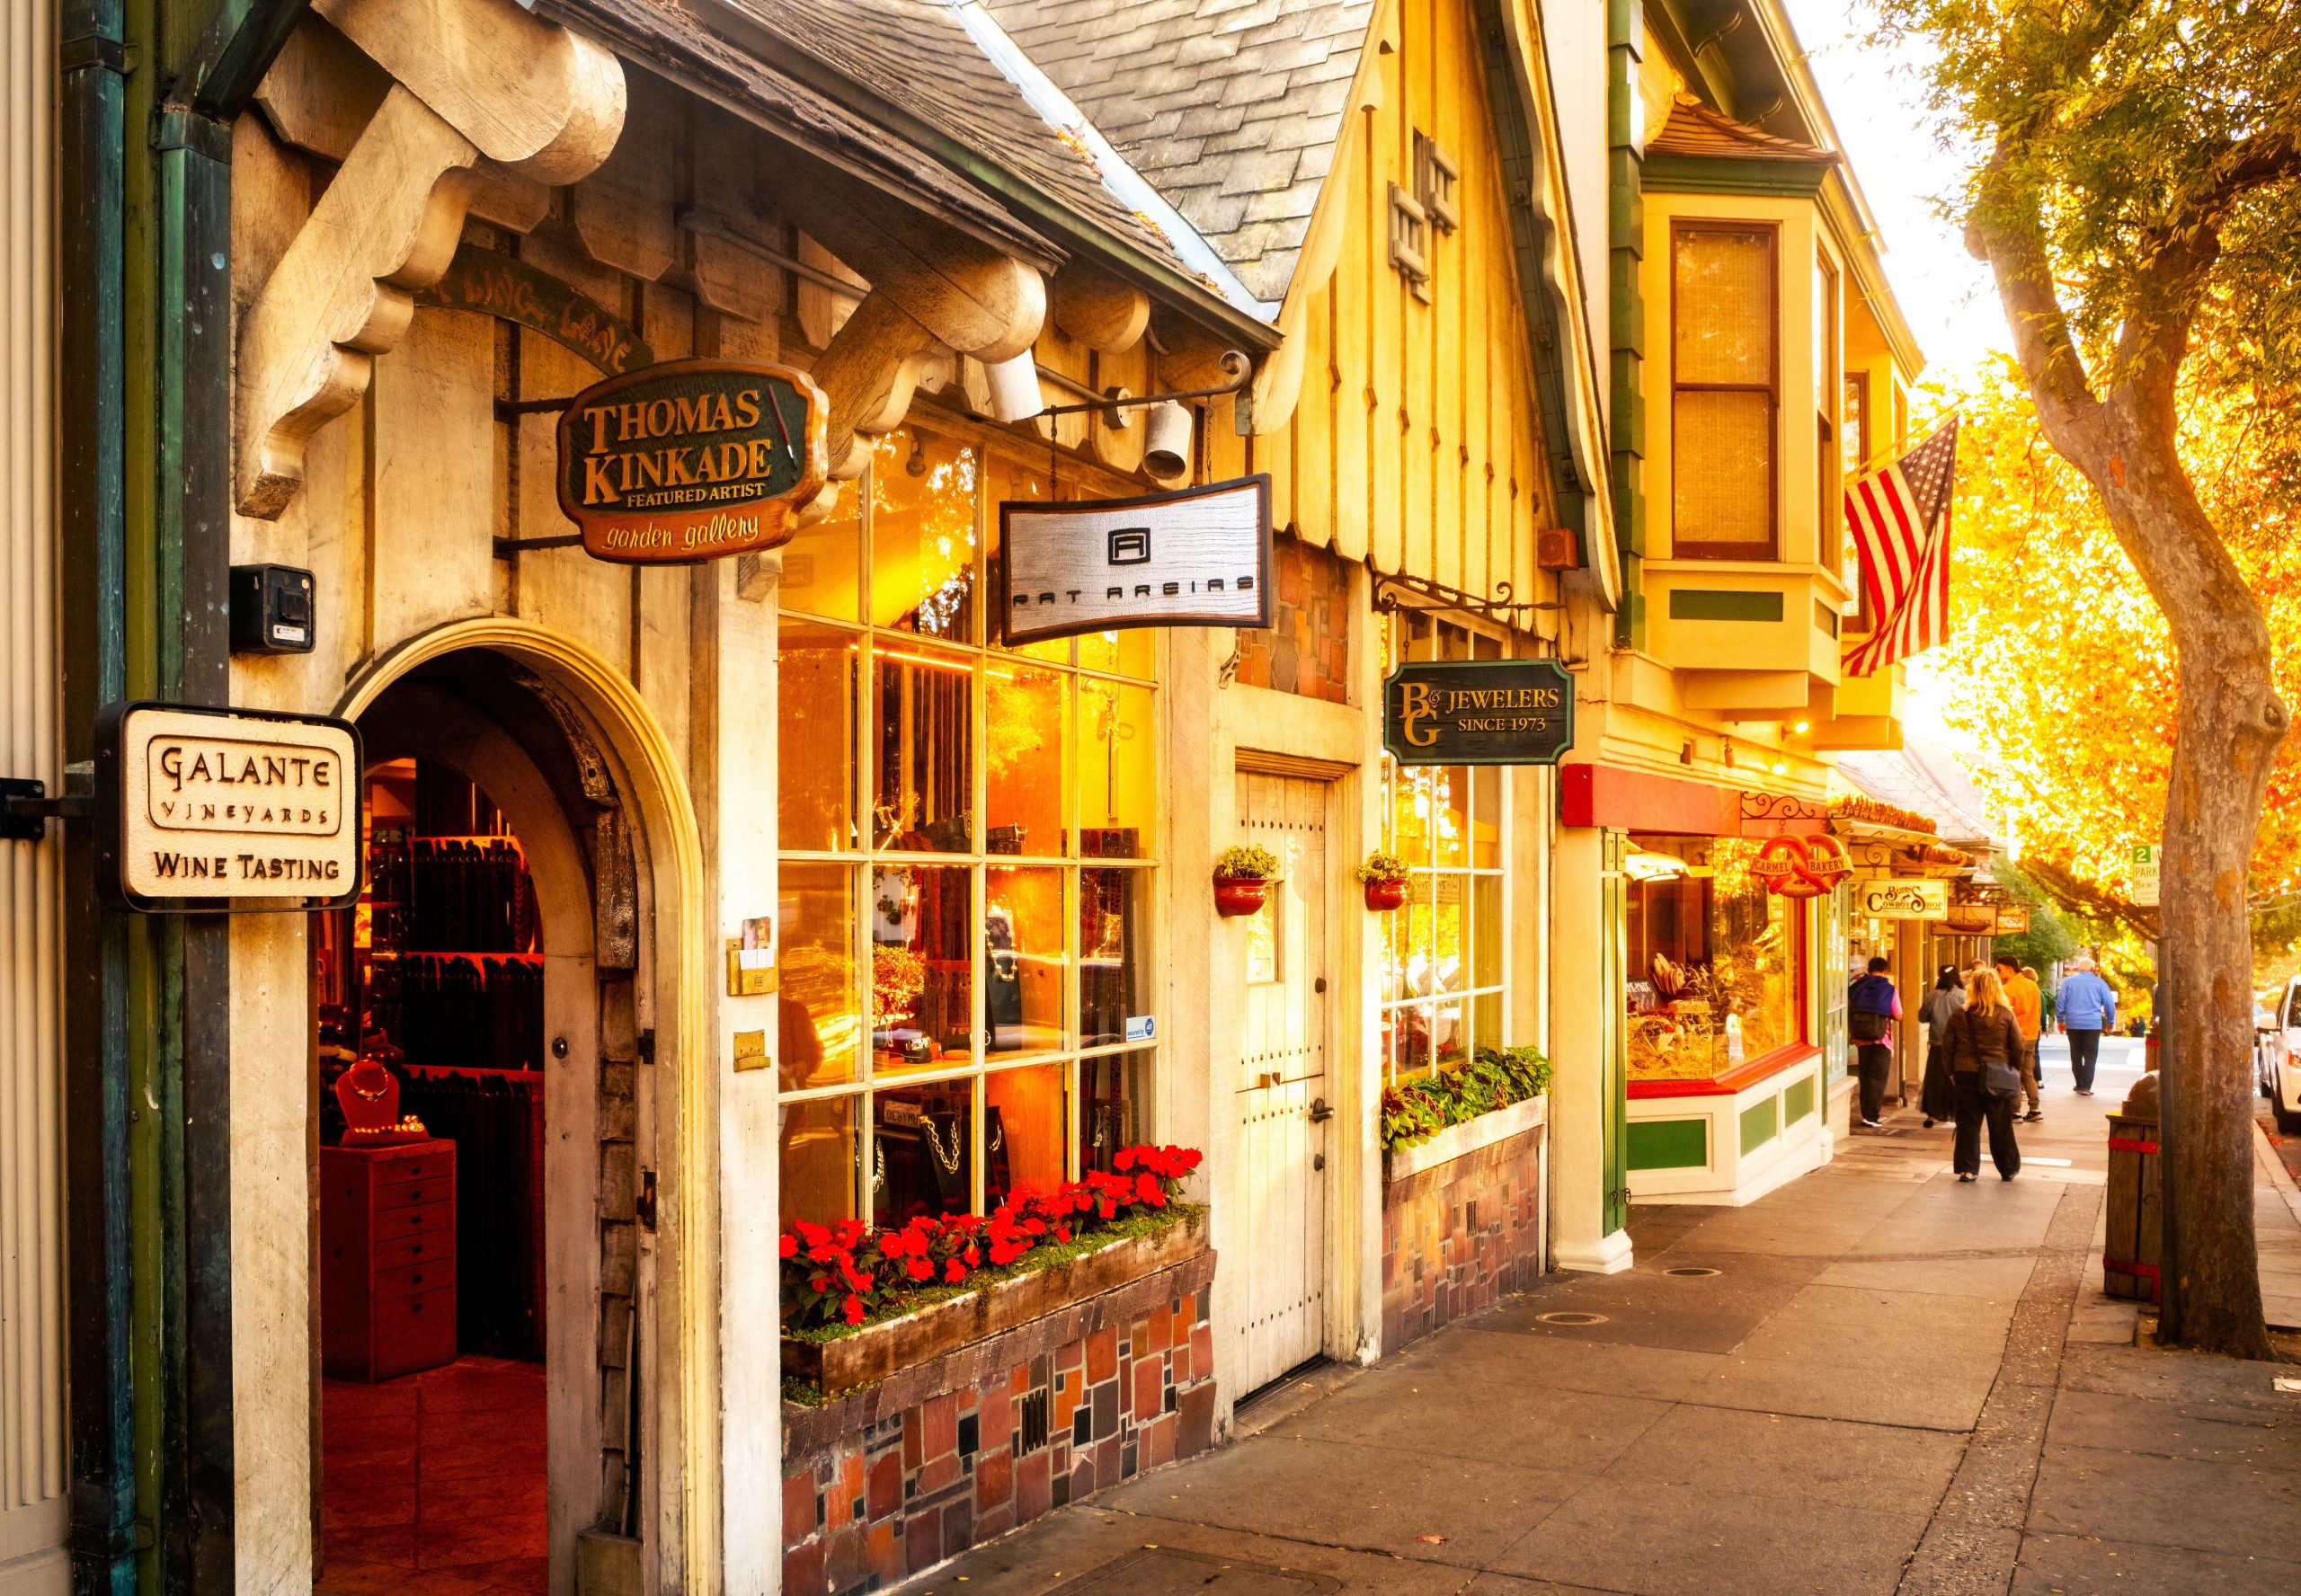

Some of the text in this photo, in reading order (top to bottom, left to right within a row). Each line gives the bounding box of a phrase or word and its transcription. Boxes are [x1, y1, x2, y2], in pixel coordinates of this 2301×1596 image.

[584, 389, 760, 454] THOMAS
[583, 439, 772, 505] KINKADE
[627, 483, 765, 508] FEATURED ARTIST
[602, 512, 760, 550] garden gallery
[1012, 575, 1254, 607] PAT AREIAS
[1445, 688, 1559, 714] JEWELERS
[1458, 717, 1546, 732] SINCE 1973
[160, 747, 330, 792] GALANTE
[161, 802, 328, 823] VINEYARDS
[154, 851, 340, 880] WINE TASTING
[1755, 858, 1844, 873] CARMEL BAKERY
[2137, 847, 2147, 862] 2
[1867, 892, 1911, 912] COWBOY
